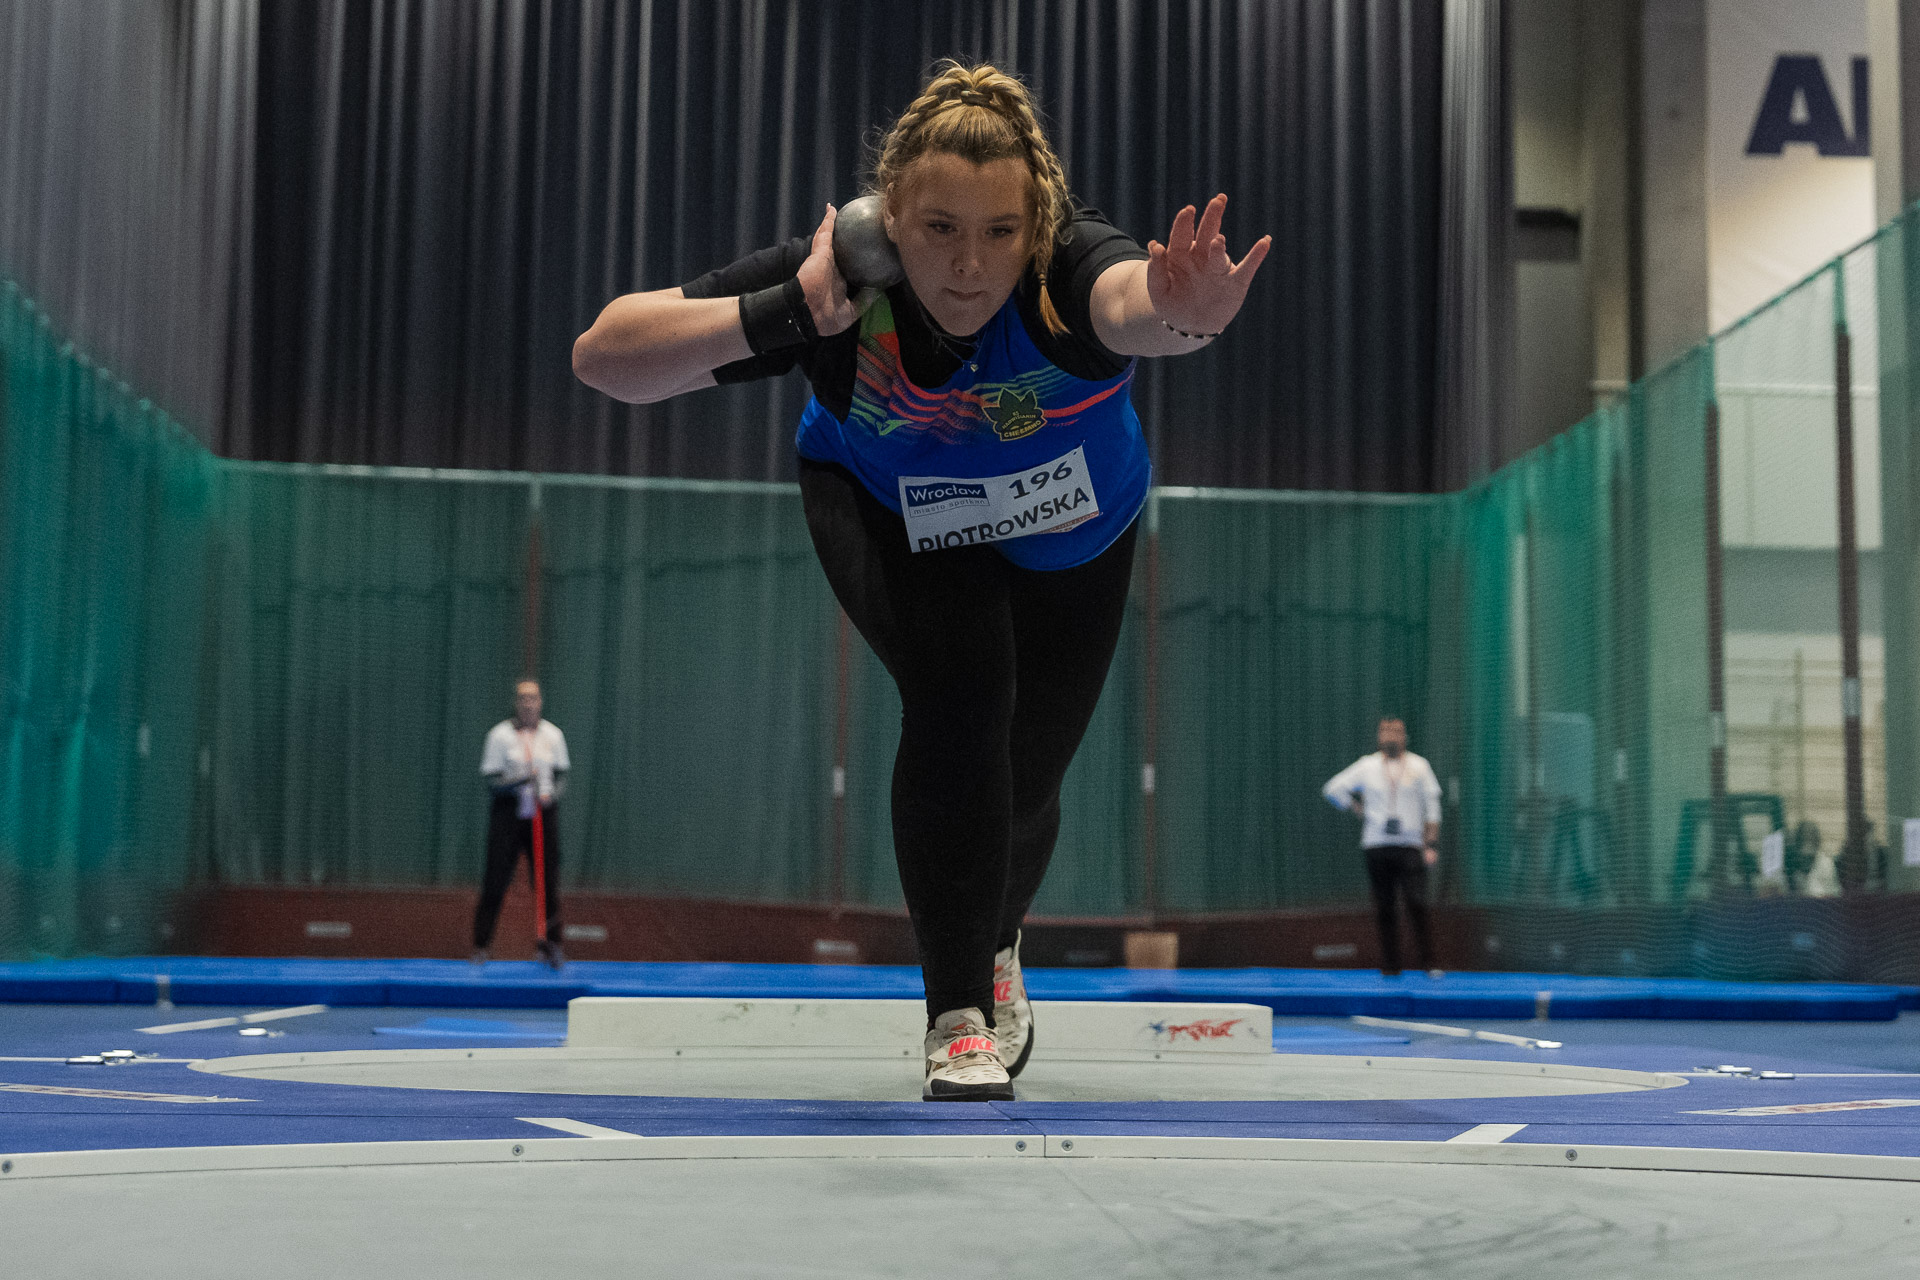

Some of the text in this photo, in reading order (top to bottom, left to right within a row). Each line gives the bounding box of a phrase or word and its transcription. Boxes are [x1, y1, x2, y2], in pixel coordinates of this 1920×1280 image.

[1009, 461, 1072, 499] 196
[910, 485, 981, 501] Wrocław
[914, 504, 945, 514] miasto
[918, 487, 1090, 551] PIOTROWSKA
[948, 1037, 995, 1057] NIKE
